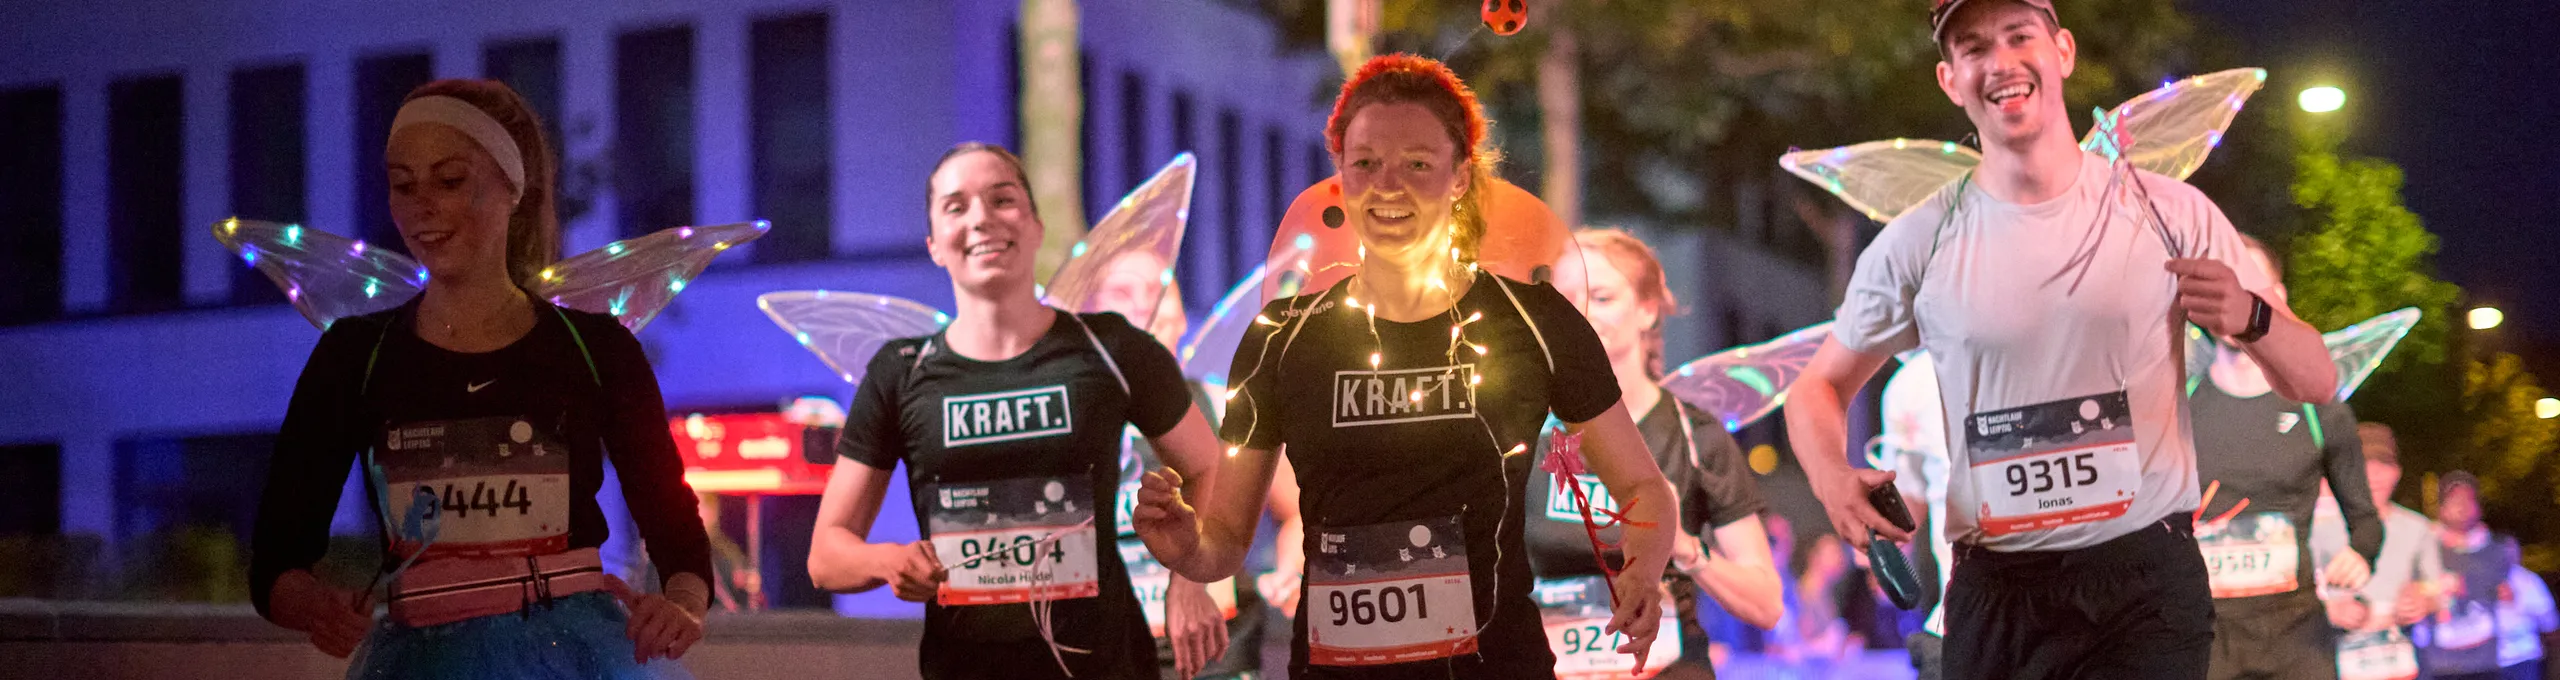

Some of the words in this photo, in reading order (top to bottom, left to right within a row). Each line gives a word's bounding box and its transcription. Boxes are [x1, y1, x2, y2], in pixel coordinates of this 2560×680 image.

[951, 395, 1063, 438] KRAFT.
[2006, 453, 2098, 497] 9315
[2038, 496, 2073, 509] Jonas
[961, 535, 1065, 569] 9404
[978, 573, 1016, 585] Nicola
[1329, 583, 1428, 626] 9601
[1563, 625, 1622, 655] 927
